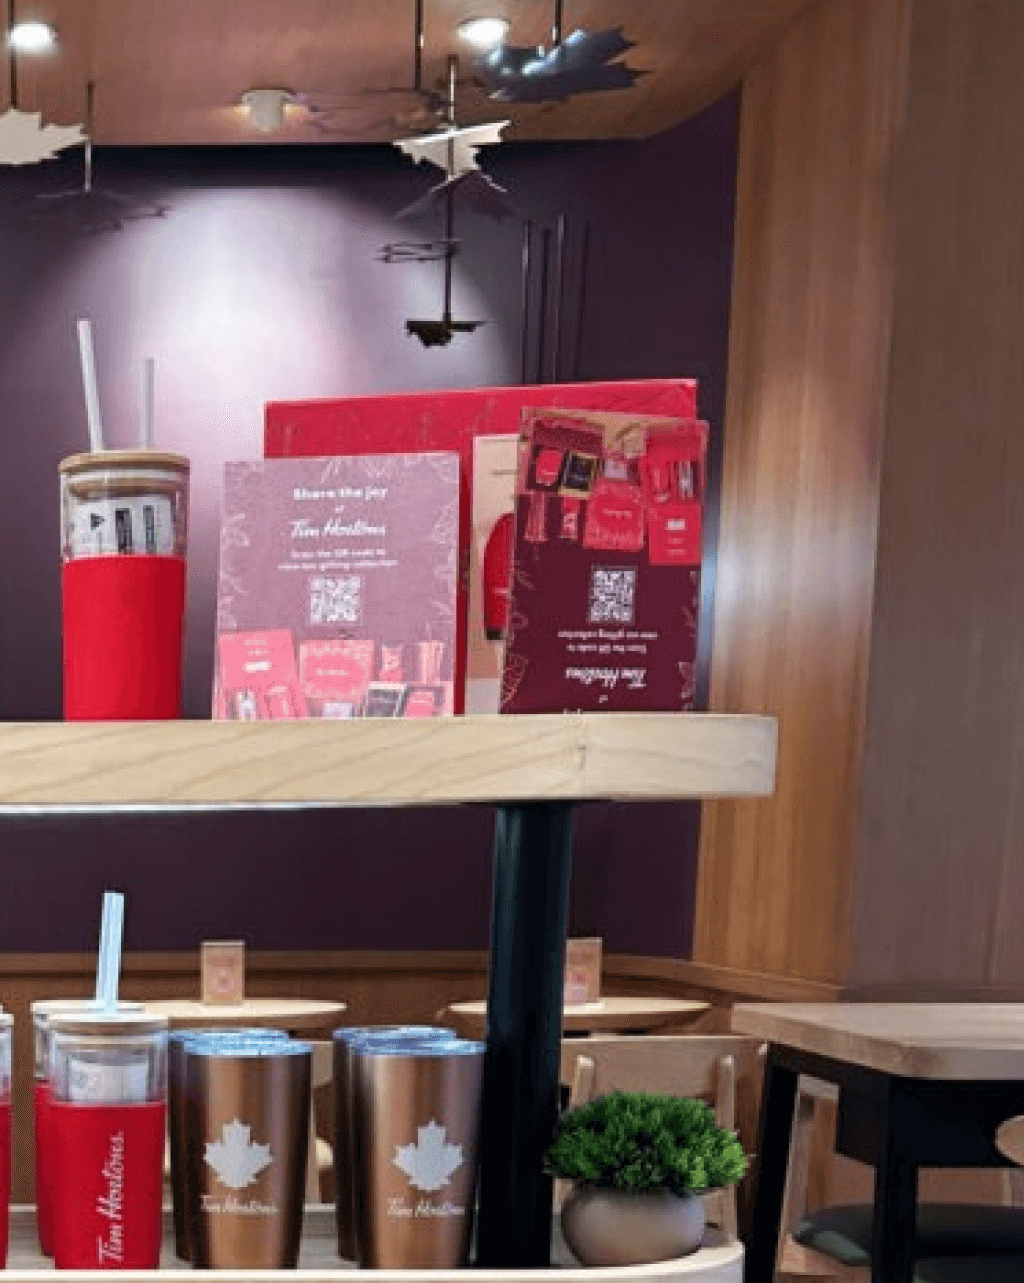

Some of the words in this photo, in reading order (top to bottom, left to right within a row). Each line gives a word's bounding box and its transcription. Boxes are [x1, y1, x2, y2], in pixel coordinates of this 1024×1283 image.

[293, 487, 336, 500] Share
[340, 486, 362, 499] the
[95, 1129, 124, 1220] Hortons
[95, 1223, 124, 1264] Tim
